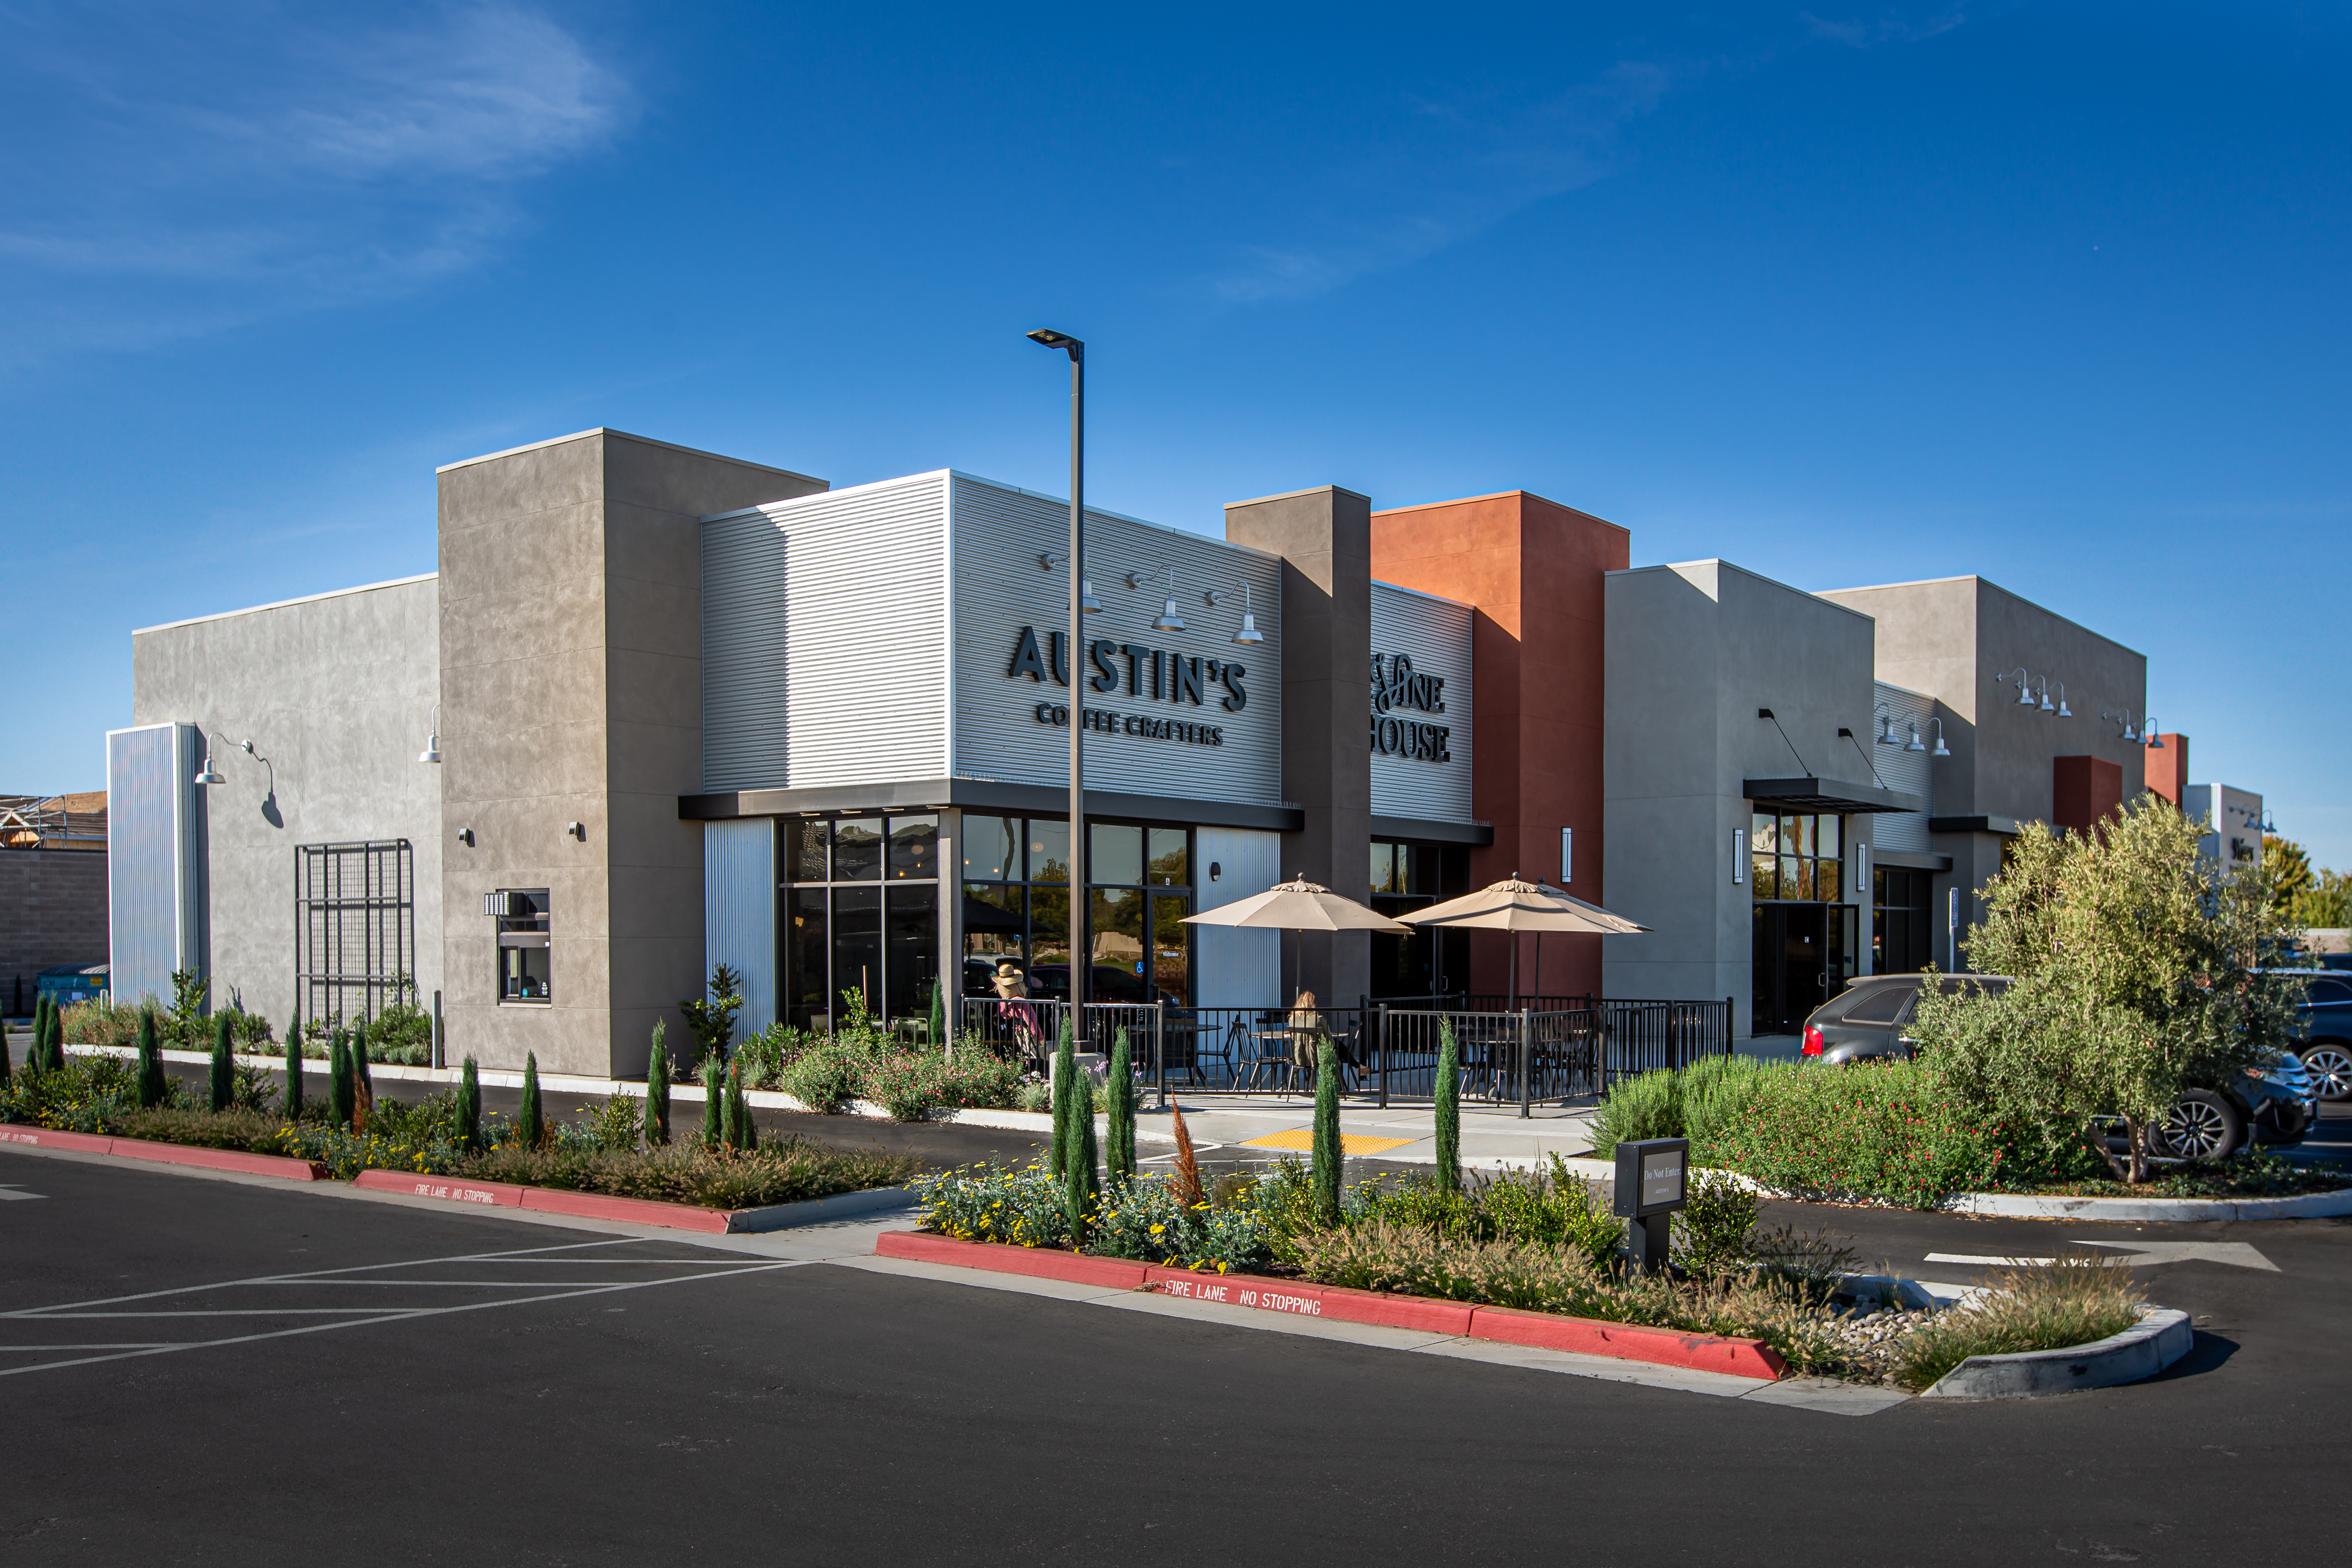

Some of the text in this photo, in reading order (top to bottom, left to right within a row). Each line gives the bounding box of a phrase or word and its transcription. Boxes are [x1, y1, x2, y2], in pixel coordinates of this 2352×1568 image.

[1036, 702, 1224, 746] COFEE CRAFTERS
[19, 1134, 38, 1145] STOPPING
[1644, 1167, 1681, 1180] Do Not Enter.
[415, 1183, 494, 1203] FIRE LANE NO STOPPING
[1165, 1280, 1321, 1315] FIRE LANE NO STOPPING
